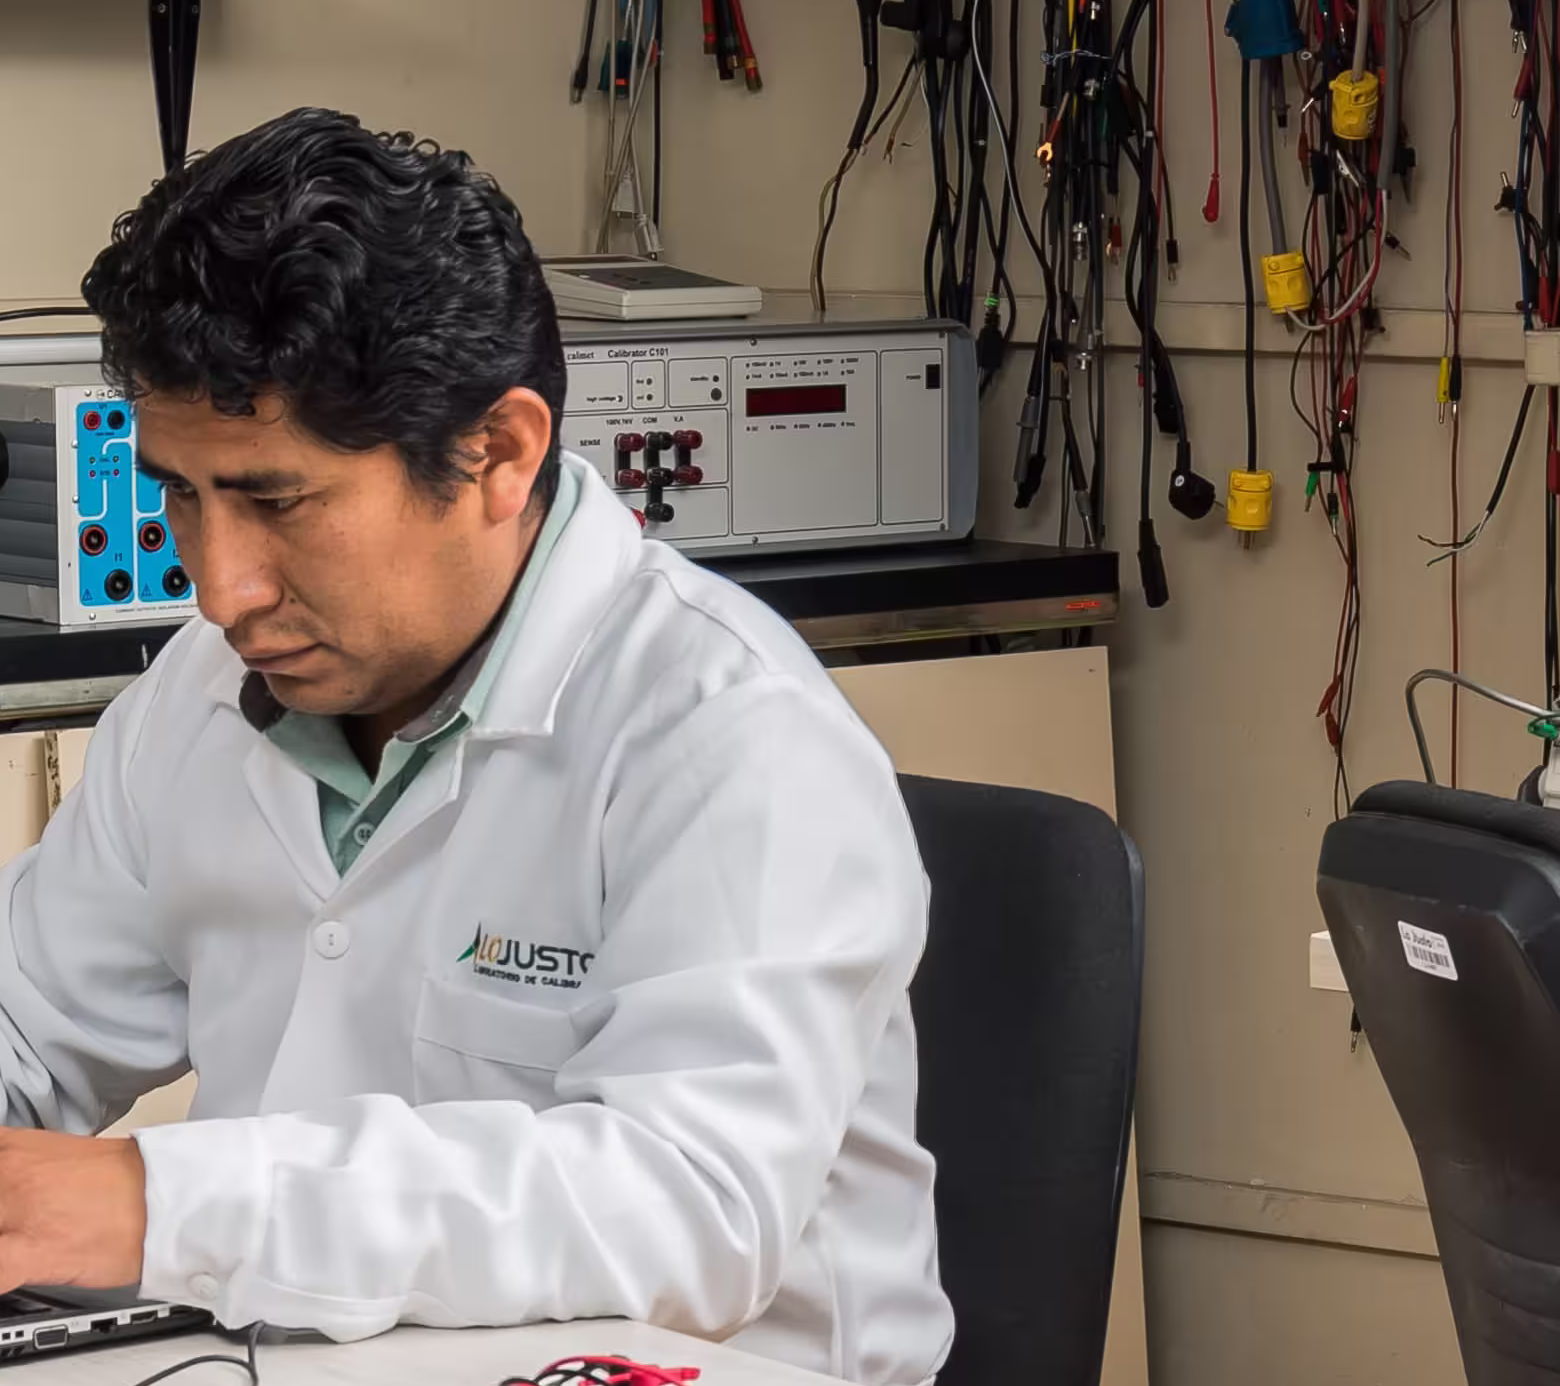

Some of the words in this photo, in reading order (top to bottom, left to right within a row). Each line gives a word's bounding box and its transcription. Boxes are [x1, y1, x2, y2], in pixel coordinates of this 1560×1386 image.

[607, 348, 647, 359] Calibrator
[648, 347, 670, 357] C101
[642, 416, 658, 424] COM
[579, 439, 601, 447] SENSE
[525, 974, 537, 985] DE
